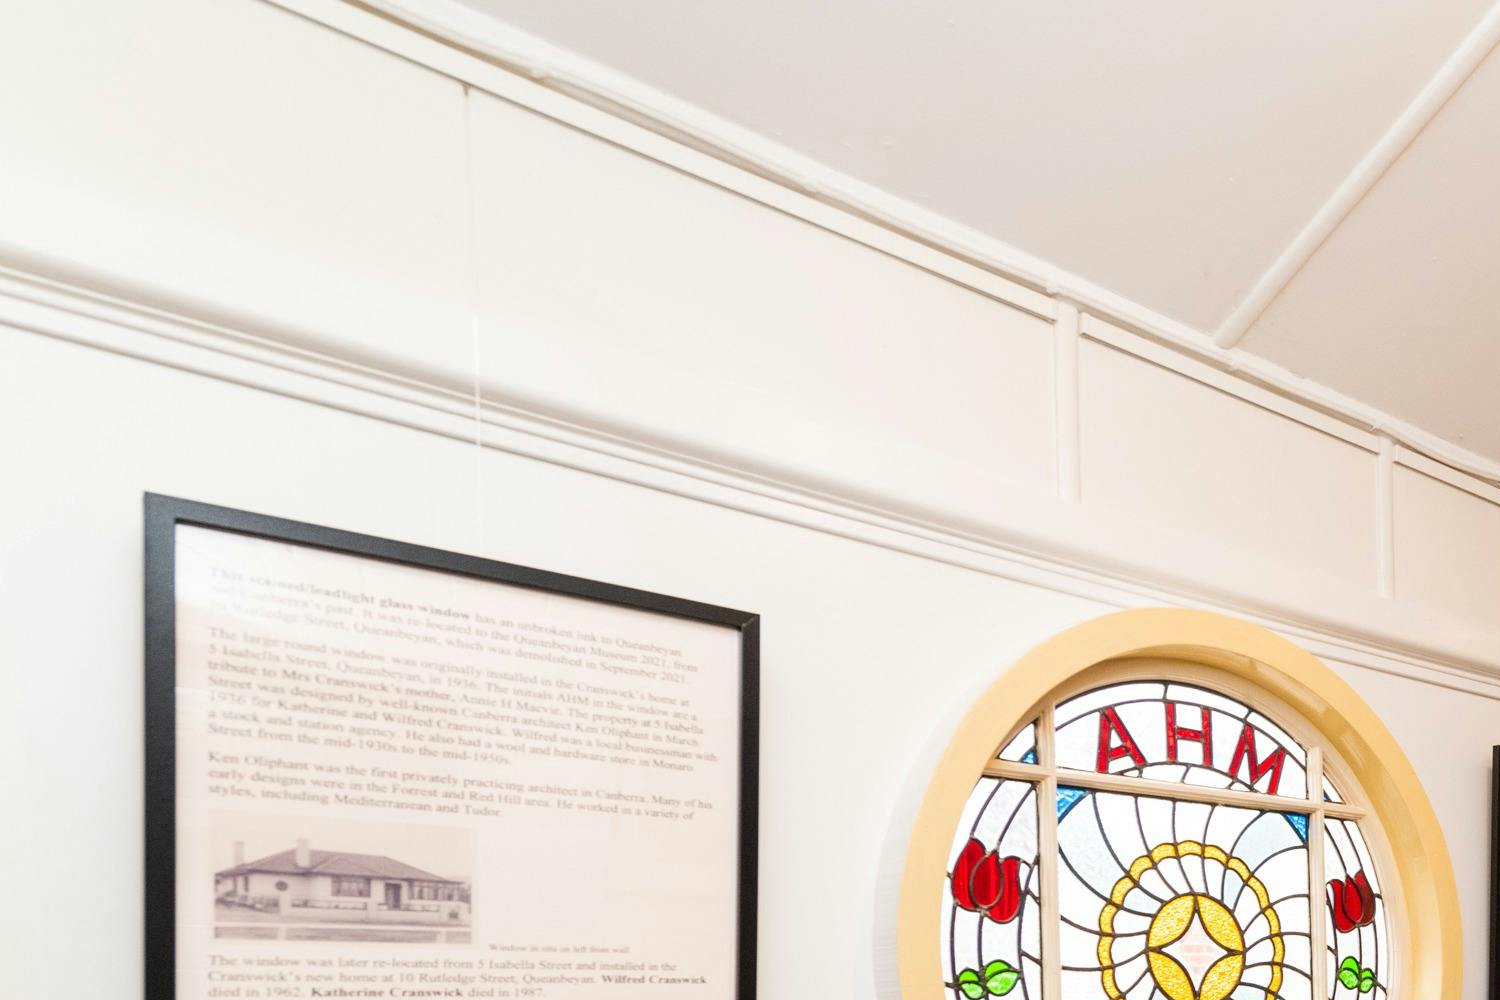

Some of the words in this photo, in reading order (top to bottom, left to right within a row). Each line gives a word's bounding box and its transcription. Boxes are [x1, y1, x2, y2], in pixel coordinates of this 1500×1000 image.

[1096, 701, 1290, 795] AHM
[208, 751, 240, 763] Ken
[244, 754, 310, 770] Oliphant
[313, 764, 341, 773] was
[345, 765, 367, 776] the
[371, 767, 398, 779] first
[581, 788, 592, 797] in
[651, 795, 681, 808] Many
[684, 799, 696, 807] of
[698, 799, 713, 809] his
[207, 769, 246, 782] early
[250, 771, 306, 786] designs
[310, 779, 345, 789] were
[349, 780, 363, 790] in
[366, 782, 388, 793] the
[392, 784, 438, 797] Forrest
[442, 790, 465, 800] and
[469, 791, 494, 802] Red
[498, 794, 521, 805] Hill
[557, 799, 574, 809] He
[576, 803, 619, 813] worked
[621, 805, 632, 814] in
[644, 809, 679, 821] variety
[682, 812, 695, 820] of
[208, 784, 256, 798] styles,
[435, 804, 459, 813] and
[207, 971, 301, 981] Cranswick's
[339, 972, 378, 982] home
[381, 974, 394, 982] at
[419, 973, 476, 984] Rutledge
[479, 974, 519, 984] Street,
[601, 975, 645, 983] Wilfred
[648, 975, 707, 983] Cranswick
[208, 955, 238, 965] The
[242, 956, 301, 966] window
[338, 958, 368, 967] later
[373, 958, 439, 968] re-located
[443, 959, 473, 968] from
[489, 960, 536, 969] Isabella
[538, 961, 573, 969] Street
[576, 961, 596, 970] and
[600, 962, 645, 970] installed
[648, 962, 659, 970] in
[661, 963, 677, 971] the
[207, 987, 241, 997] died
[245, 987, 260, 997] in
[311, 987, 385, 996] Katherine
[389, 987, 464, 996] Cranswick
[467, 988, 495, 996] died
[498, 988, 510, 996] in
